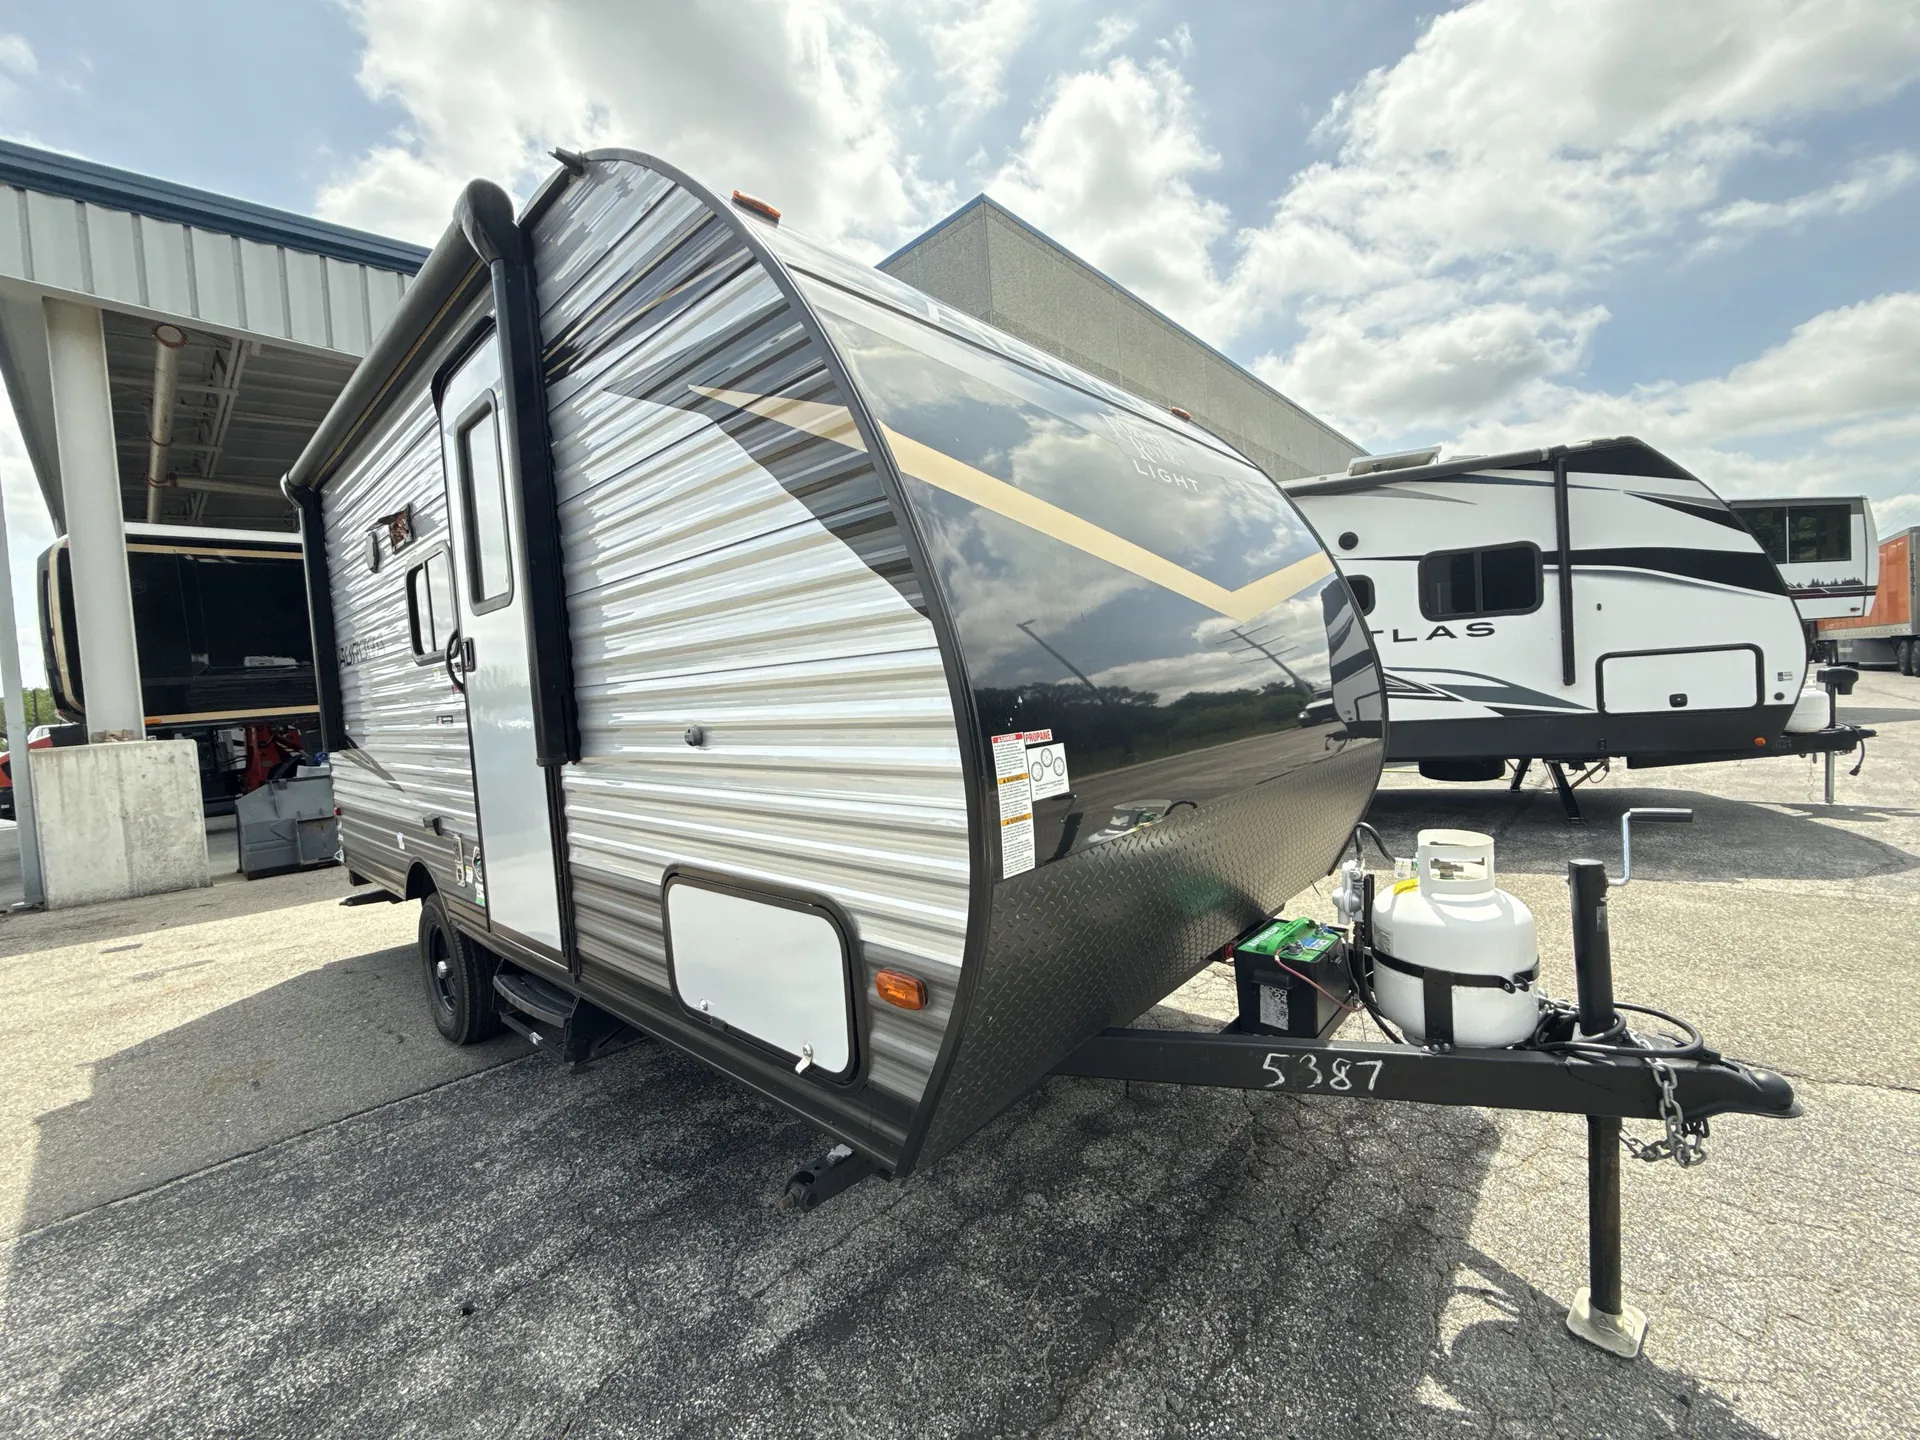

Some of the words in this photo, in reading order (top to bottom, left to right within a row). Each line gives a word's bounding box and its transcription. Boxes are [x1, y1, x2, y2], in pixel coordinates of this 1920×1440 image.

[1133, 459, 1199, 492] LIGHT
[1371, 622, 1496, 643] TLAS
[1025, 730, 1051, 743] PROPANE
[1262, 1052, 1384, 1092] 5387
